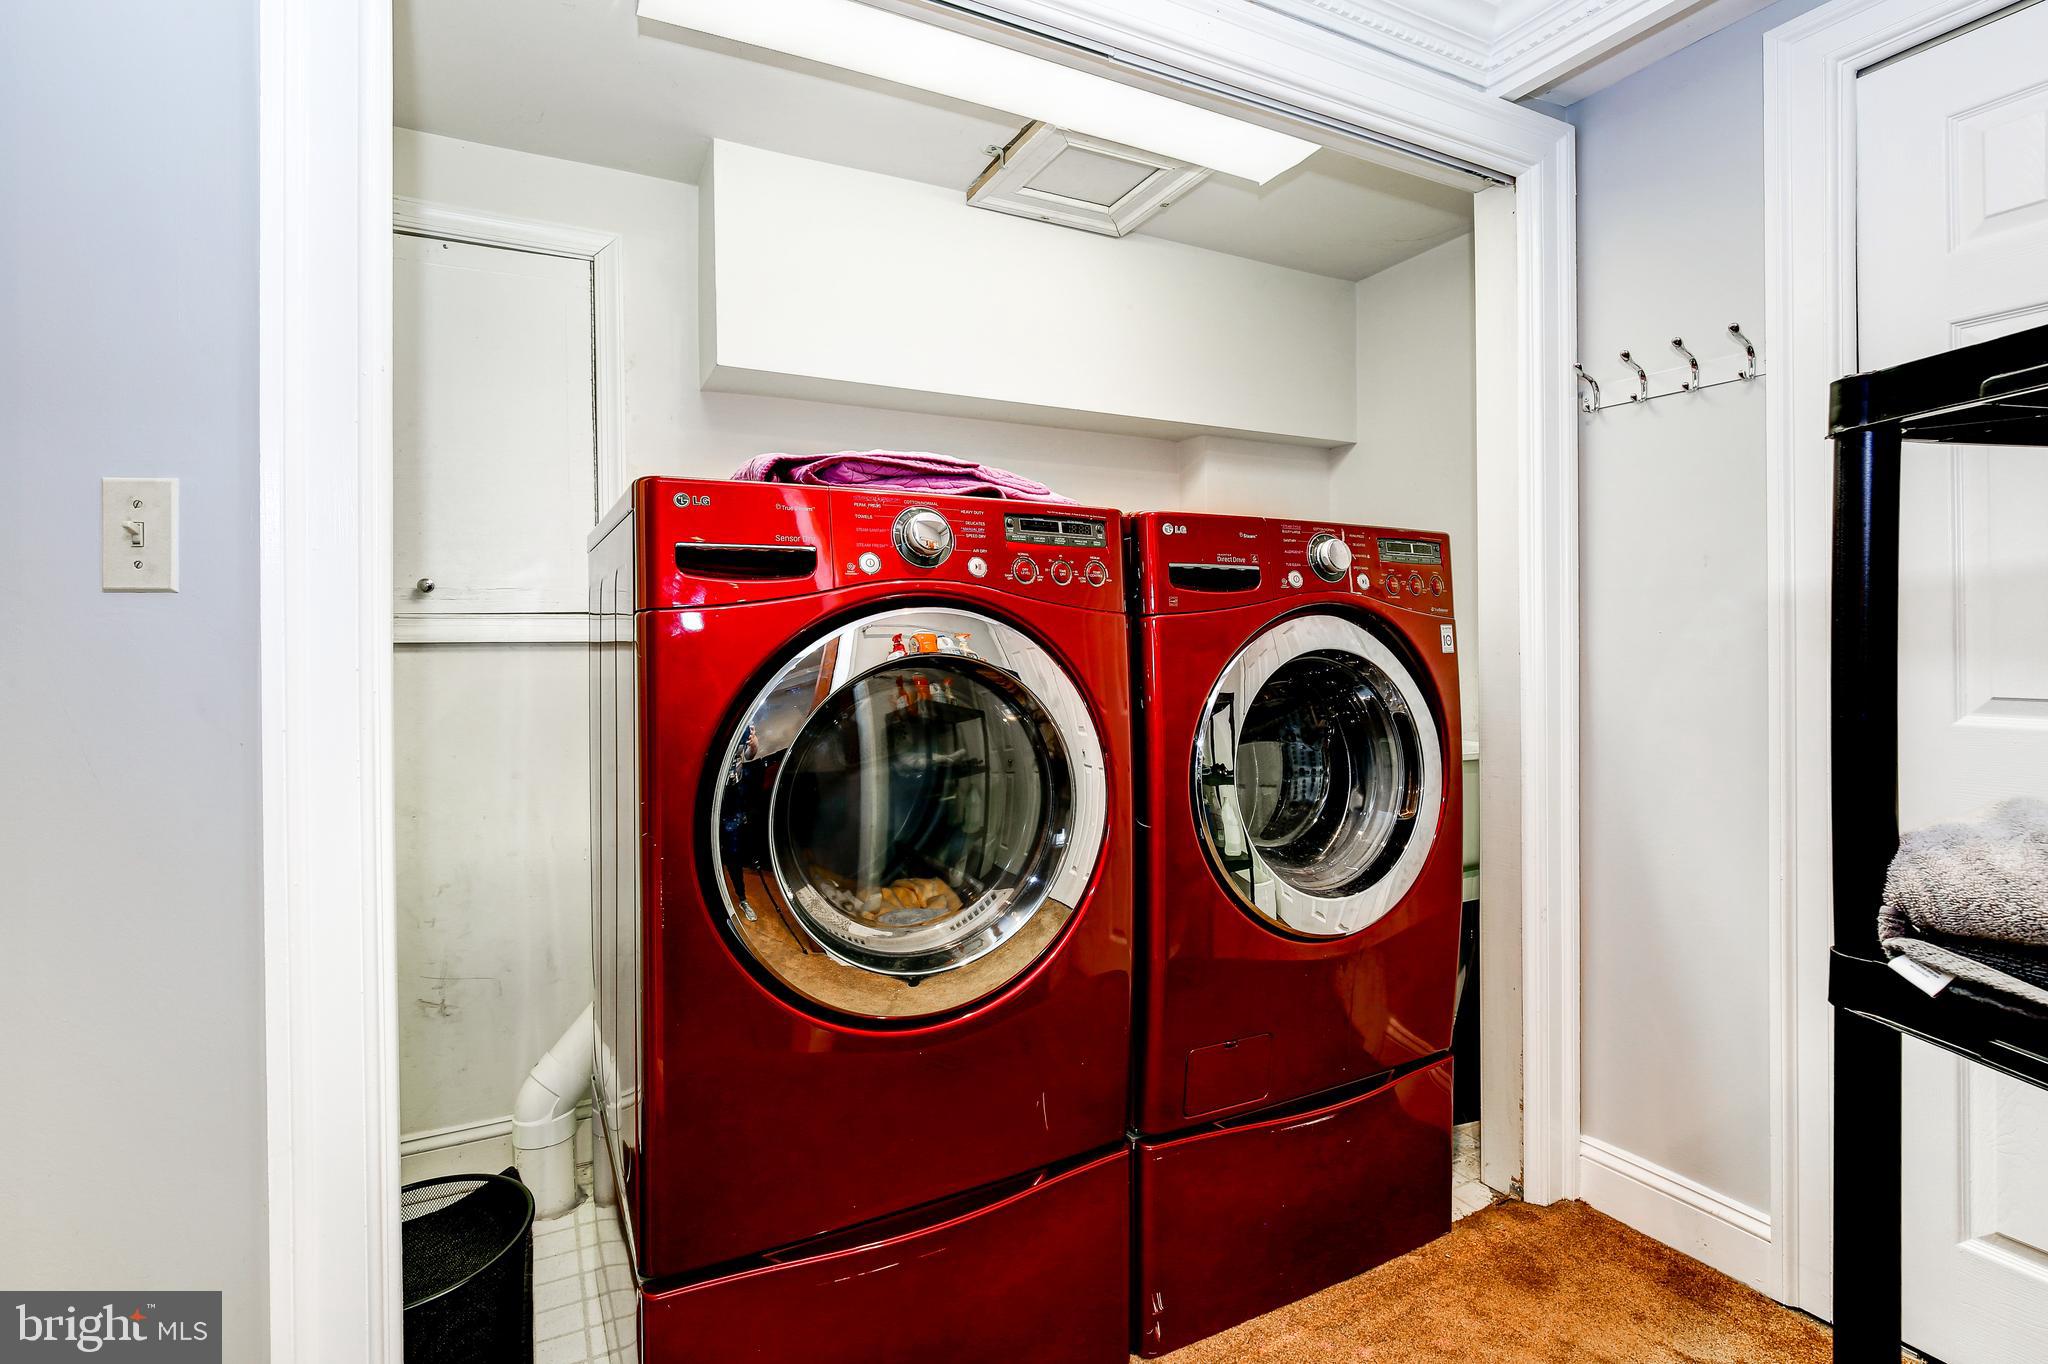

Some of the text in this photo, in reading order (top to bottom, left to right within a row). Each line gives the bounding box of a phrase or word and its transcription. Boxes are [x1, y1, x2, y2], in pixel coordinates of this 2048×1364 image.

[692, 496, 711, 506] LG
[1174, 525, 1187, 535] LG
[775, 534, 816, 544] Sensor Dry
